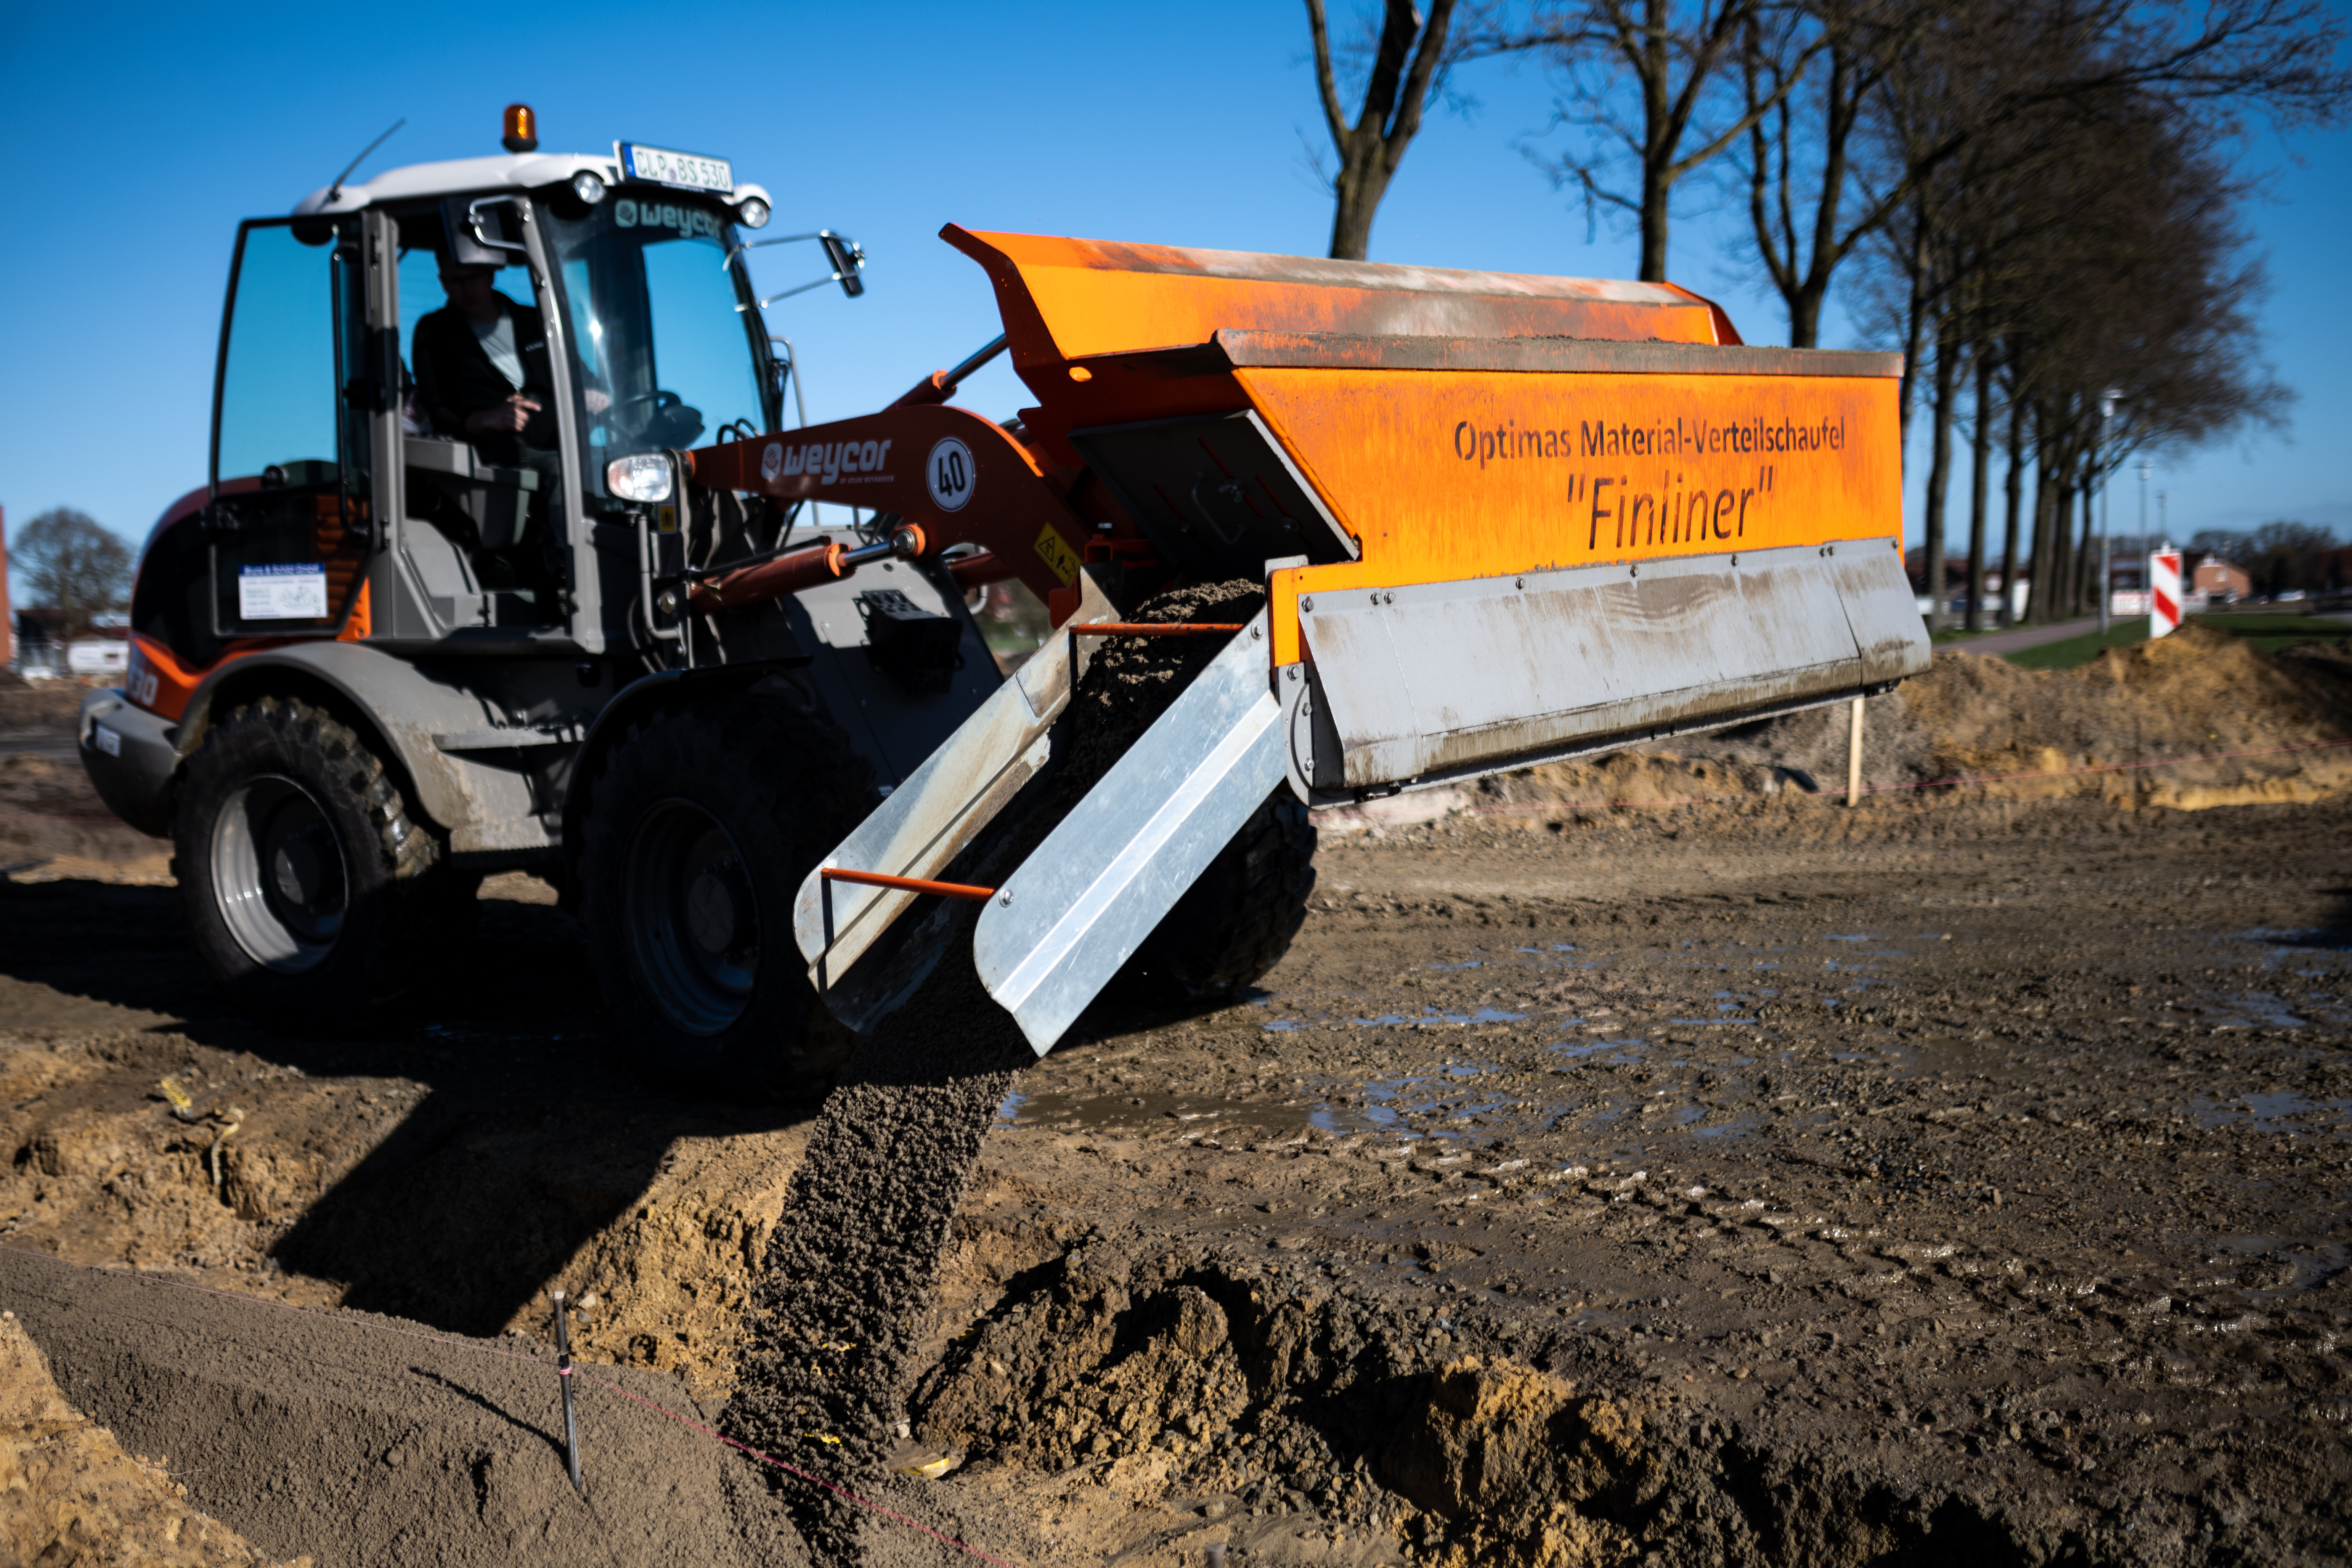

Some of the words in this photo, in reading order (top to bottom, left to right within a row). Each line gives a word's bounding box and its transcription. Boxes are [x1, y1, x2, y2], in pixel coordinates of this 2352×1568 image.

[636, 151, 666, 179] CLP
[677, 158, 698, 182] BS
[700, 162, 729, 187] 530
[640, 202, 721, 238] weycor
[783, 440, 891, 485] weycor
[1454, 420, 1571, 470] Optimas
[1581, 416, 1845, 457] Material-Verteilschaufel
[938, 451, 965, 497] 40
[1567, 465, 1774, 550] "Finliner"
